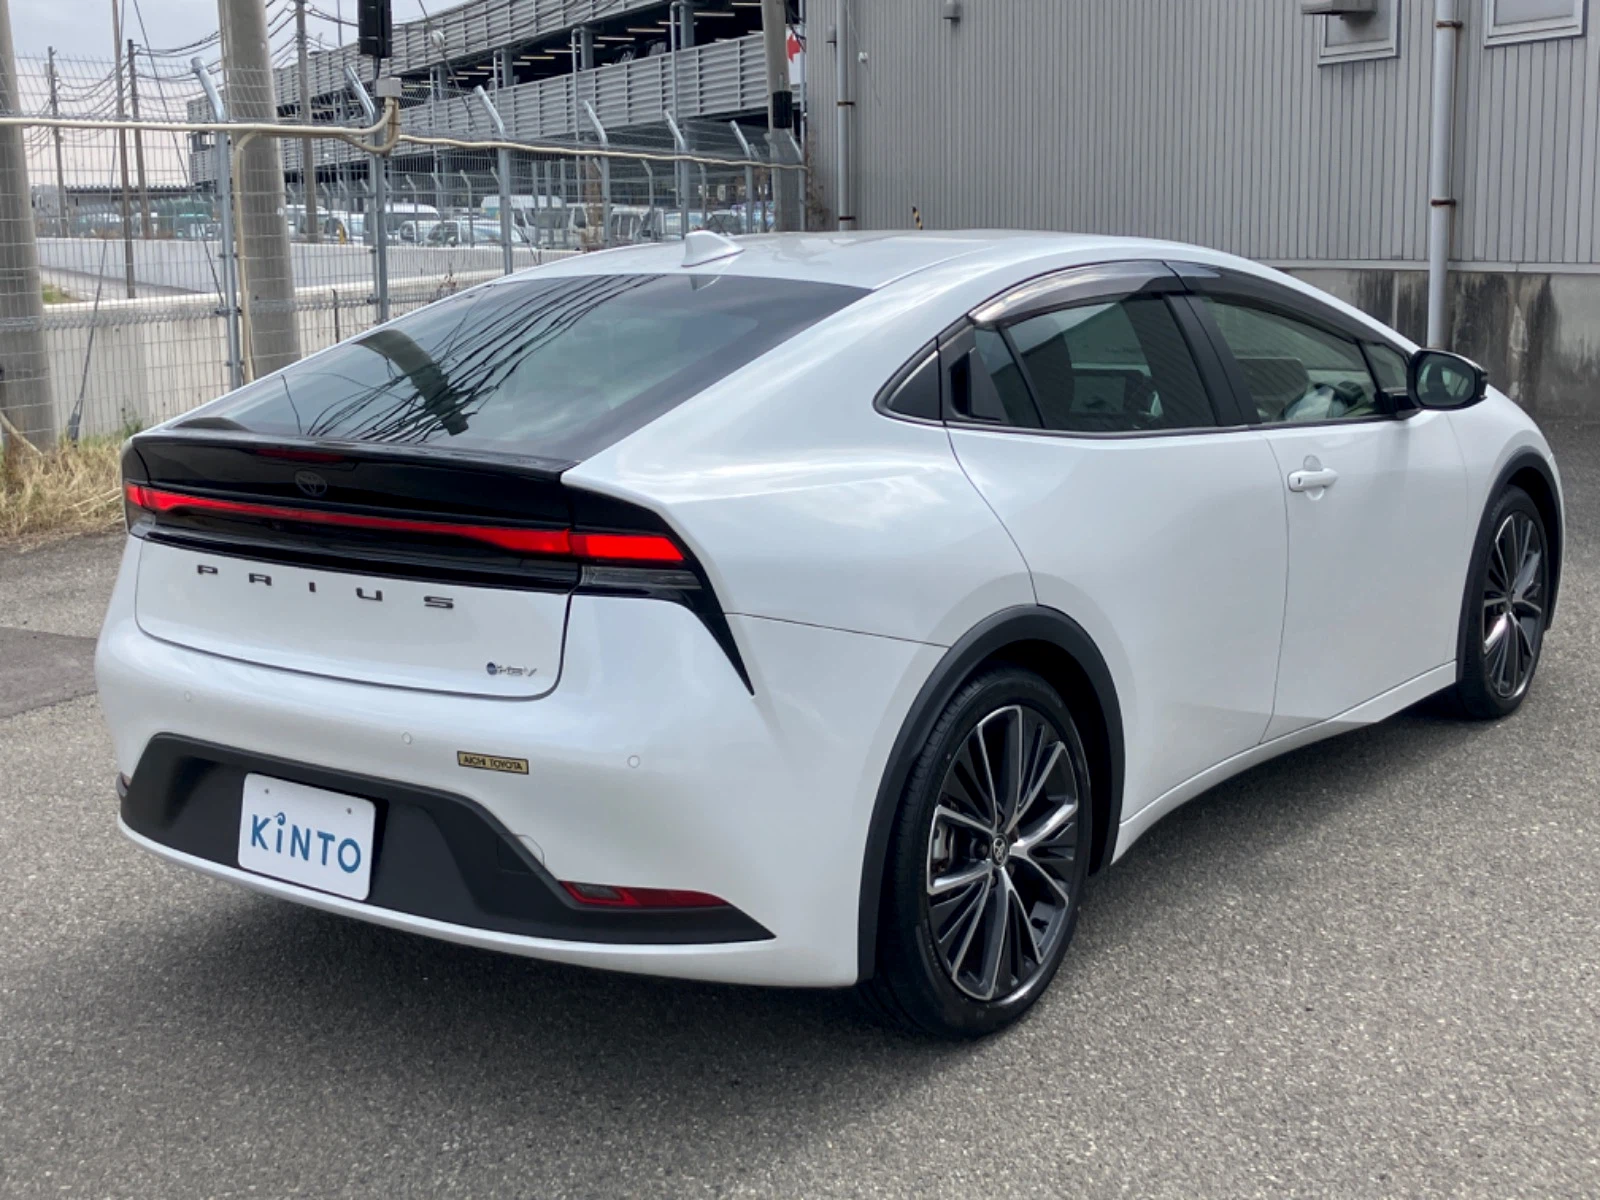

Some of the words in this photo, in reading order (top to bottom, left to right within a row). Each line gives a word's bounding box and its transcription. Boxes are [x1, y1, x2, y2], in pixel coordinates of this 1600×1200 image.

[197, 565, 454, 609] PRIUS
[463, 755, 487, 766] AICHI
[490, 758, 523, 771] TOYOTA
